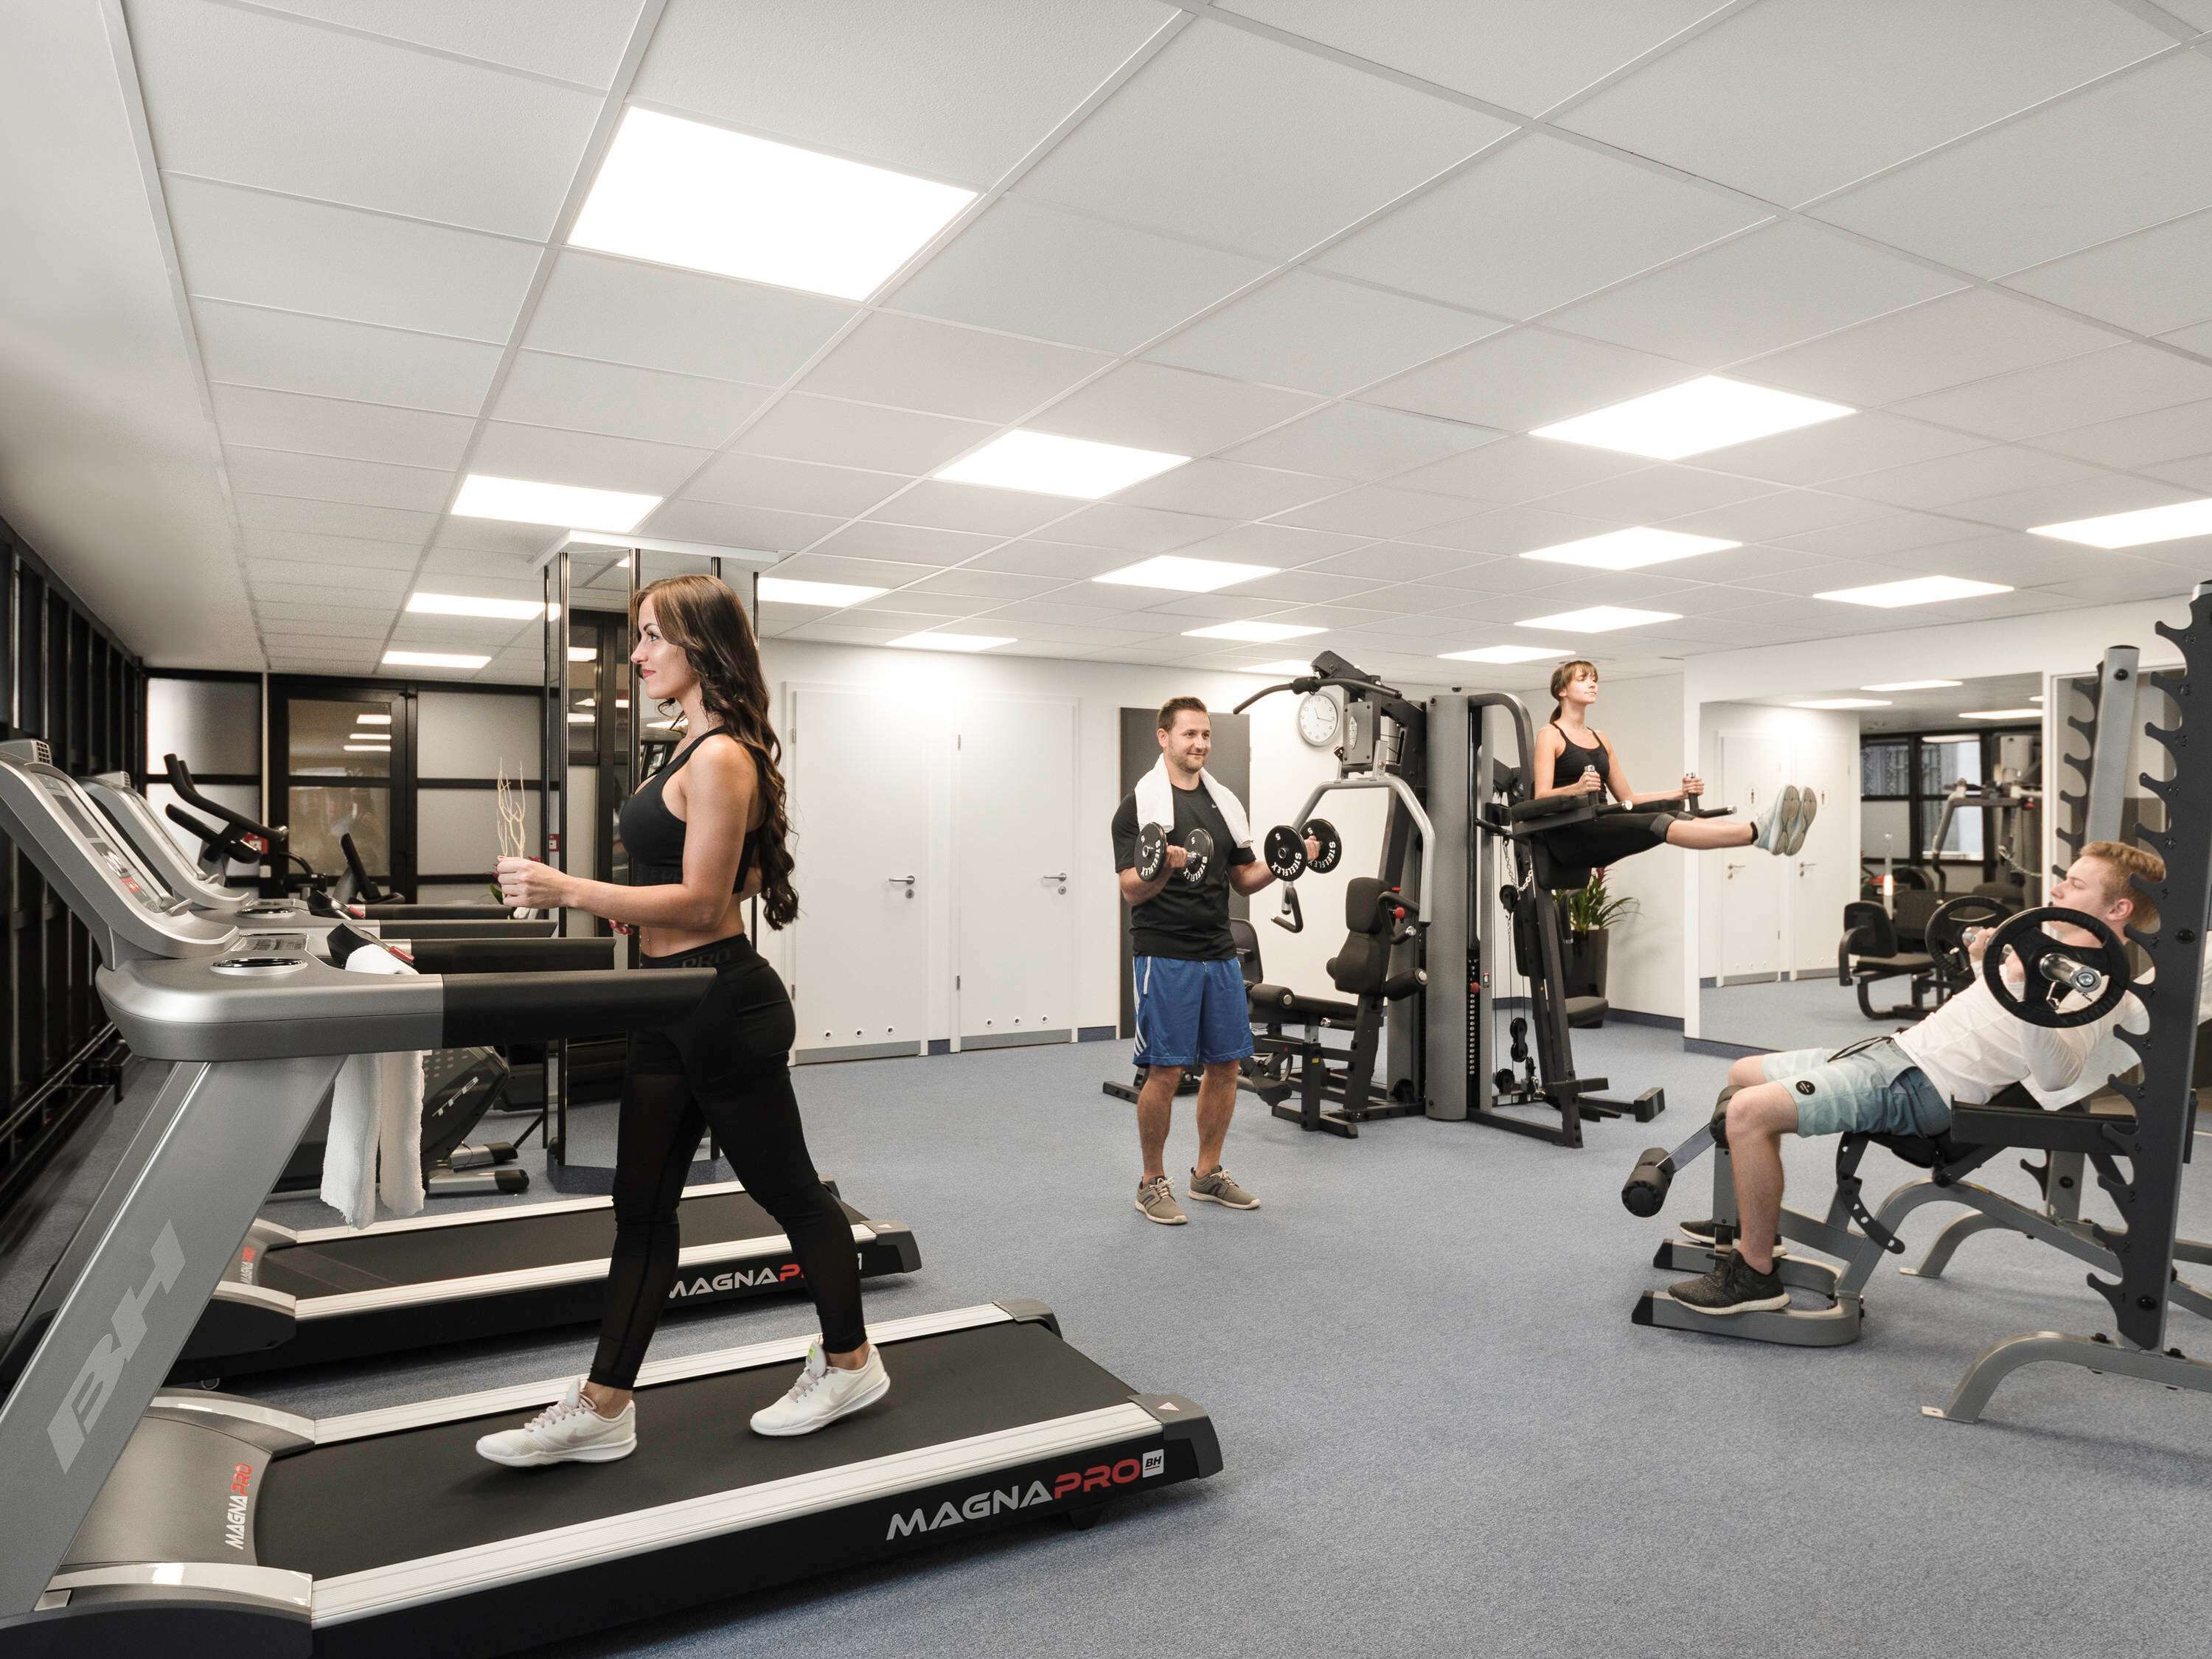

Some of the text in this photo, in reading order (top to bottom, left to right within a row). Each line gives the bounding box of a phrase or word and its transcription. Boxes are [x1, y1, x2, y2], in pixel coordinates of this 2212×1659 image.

[1140, 840, 1161, 877] STEELFLEX
[1183, 856, 1208, 882] STEELFLEX
[1270, 852, 1302, 877] STEELFLEX
[1308, 841, 1337, 869] STEELFLEX
[47, 1219, 186, 1475] BH
[224, 1462, 253, 1550] MAGNAPRO
[886, 1455, 1162, 1541] MAGNAPRO BH
